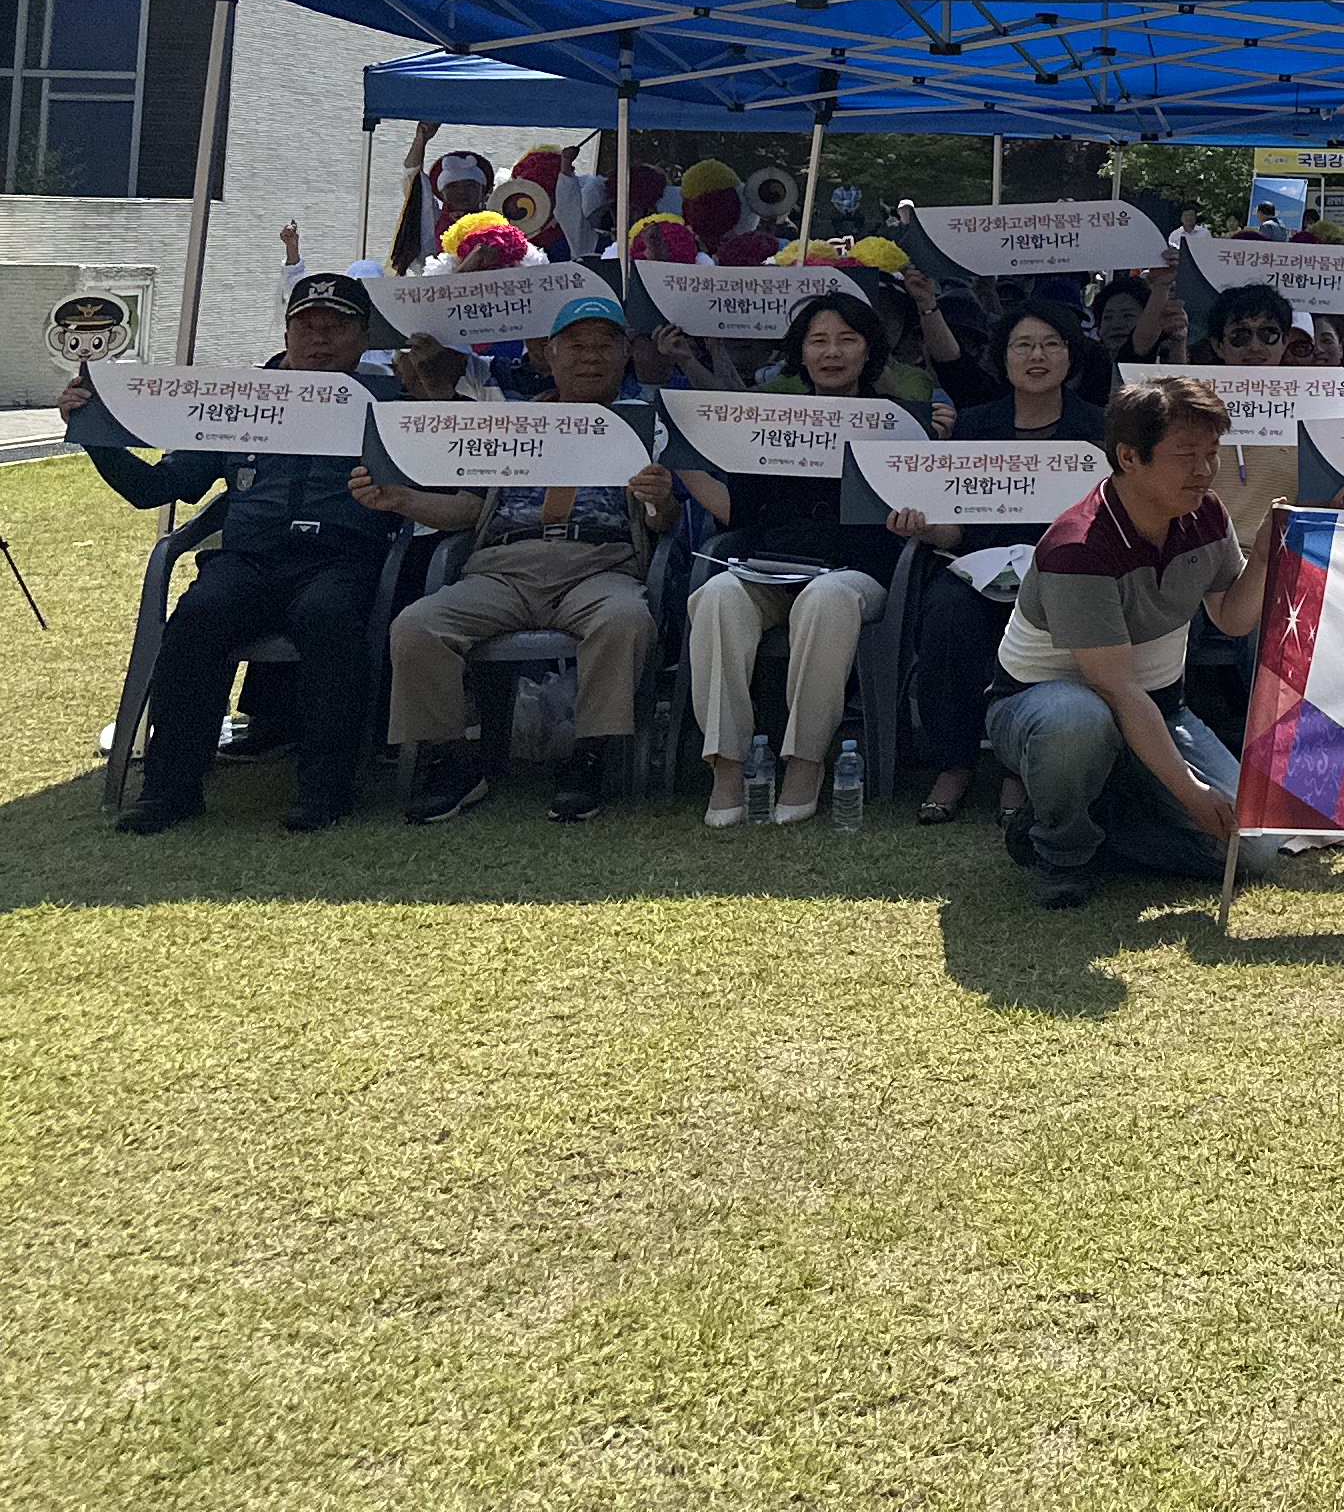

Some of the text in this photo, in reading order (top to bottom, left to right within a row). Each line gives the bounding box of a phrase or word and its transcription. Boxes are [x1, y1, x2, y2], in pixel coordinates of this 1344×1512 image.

[948, 211, 1131, 233] 국립강화고려박물관 건립을
[1001, 233, 1080, 250] 기원합니다!
[395, 272, 586, 304] 국립강화고려박물관 건립을
[663, 275, 842, 295] 국립강화고려박물관 건립을
[1266, 272, 1342, 290] 기원합니다!
[448, 299, 532, 320] 기원합니다!
[709, 298, 787, 315] 기원합니다!
[126, 377, 352, 404] 국립강화고려박물관 건립을
[1202, 379, 1300, 397] 화고려박물관
[187, 403, 284, 425] 기원합니다!
[696, 404, 899, 430] 국립강화고려박물관 건립을
[1226, 401, 1296, 419] 원합니다!
[400, 415, 610, 435] 국립강화고려박물관 건립을
[448, 438, 544, 458] 기원합니다!
[750, 429, 836, 450] 기원합니다!
[886, 454, 1098, 472] 국립강화고려박물관 건립을
[944, 477, 1036, 495] 기원합니다!
